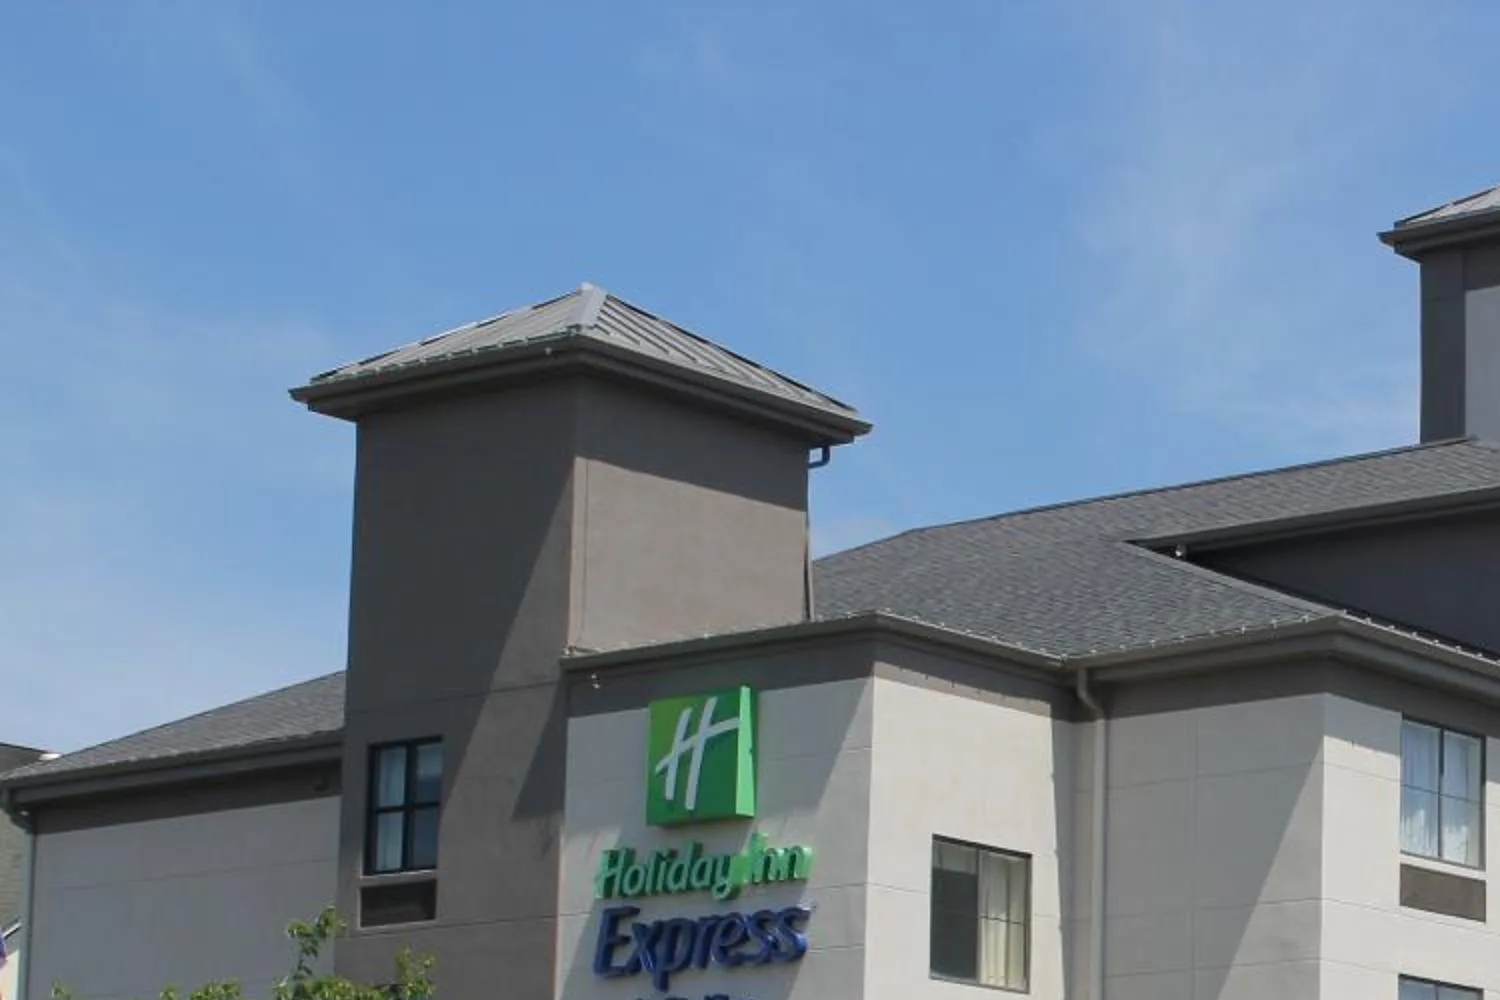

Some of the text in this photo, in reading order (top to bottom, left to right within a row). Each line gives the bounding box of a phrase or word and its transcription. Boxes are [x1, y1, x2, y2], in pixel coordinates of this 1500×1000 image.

[595, 833, 814, 900] Holiday Inn
[593, 905, 812, 992] Express
